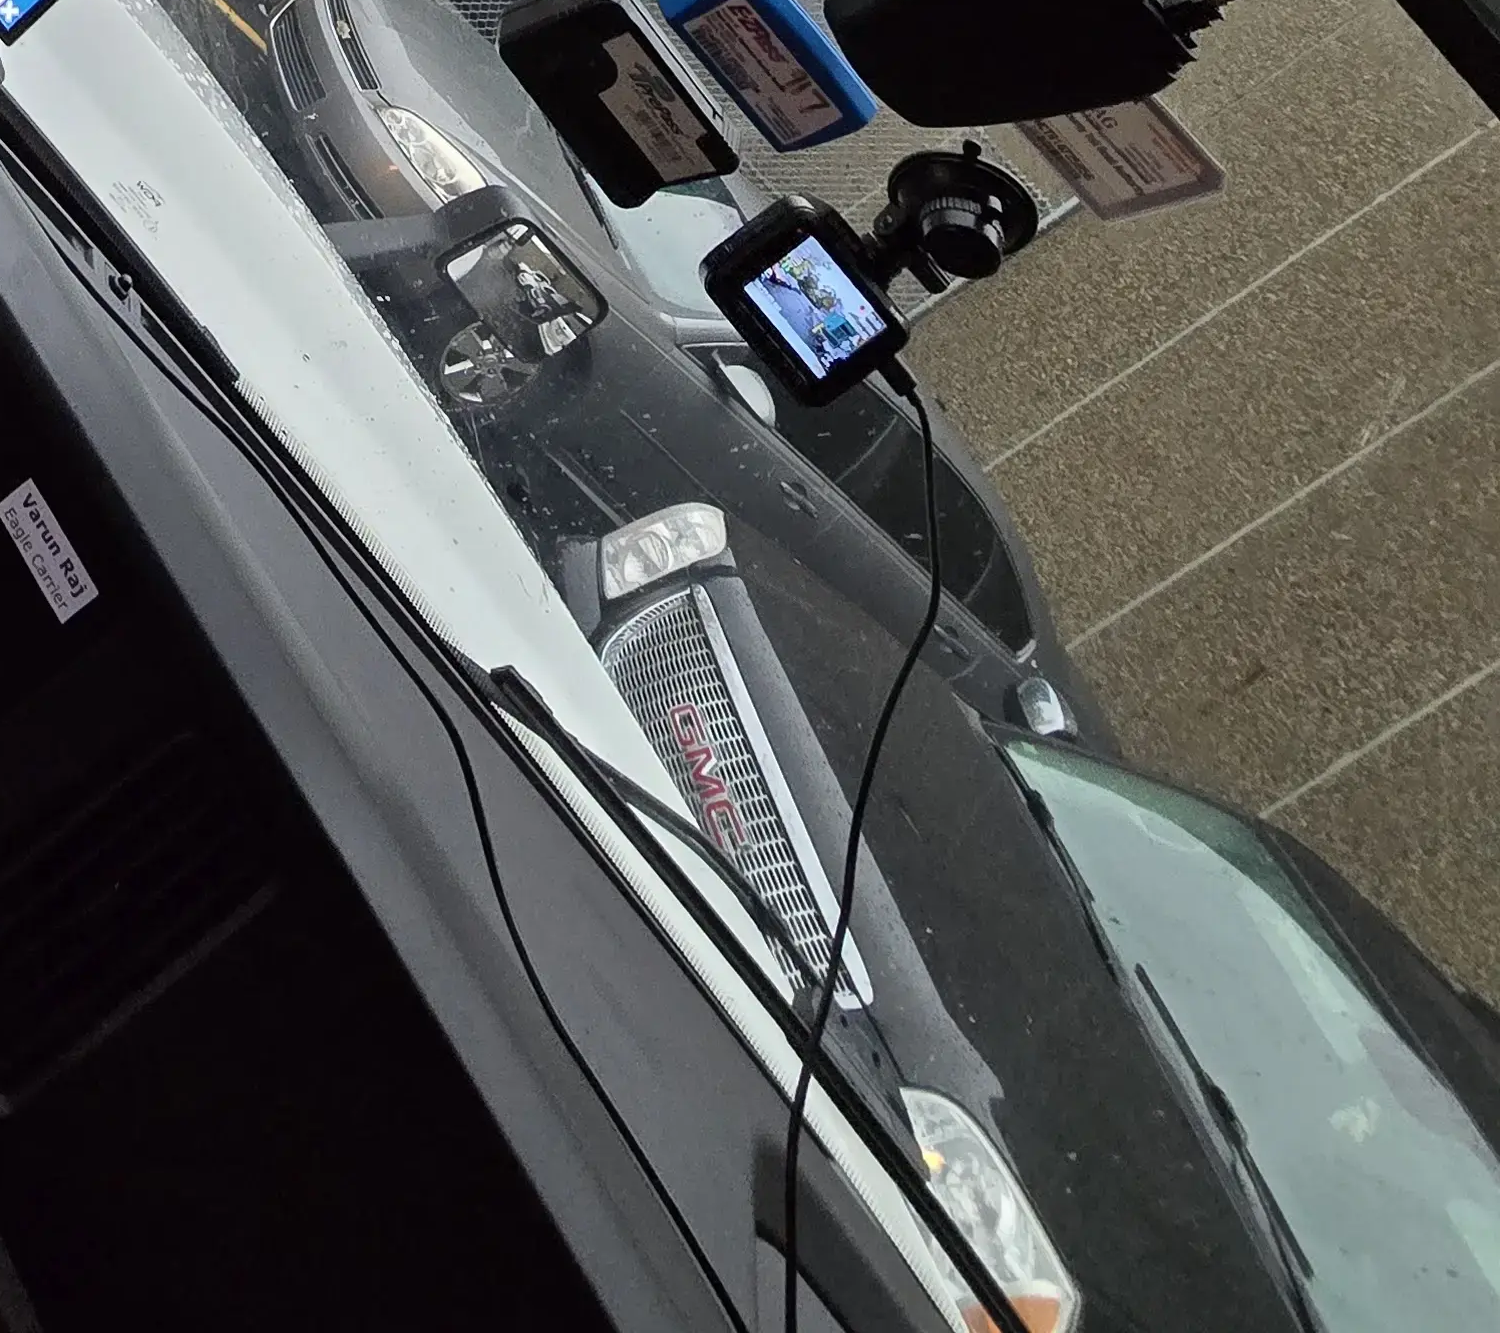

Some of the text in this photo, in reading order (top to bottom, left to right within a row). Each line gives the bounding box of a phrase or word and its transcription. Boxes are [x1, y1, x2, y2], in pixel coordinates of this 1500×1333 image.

[4, 506, 68, 610] Eagle Carrier
[22, 492, 88, 598] Varun Raj
[670, 702, 746, 848] GMC
